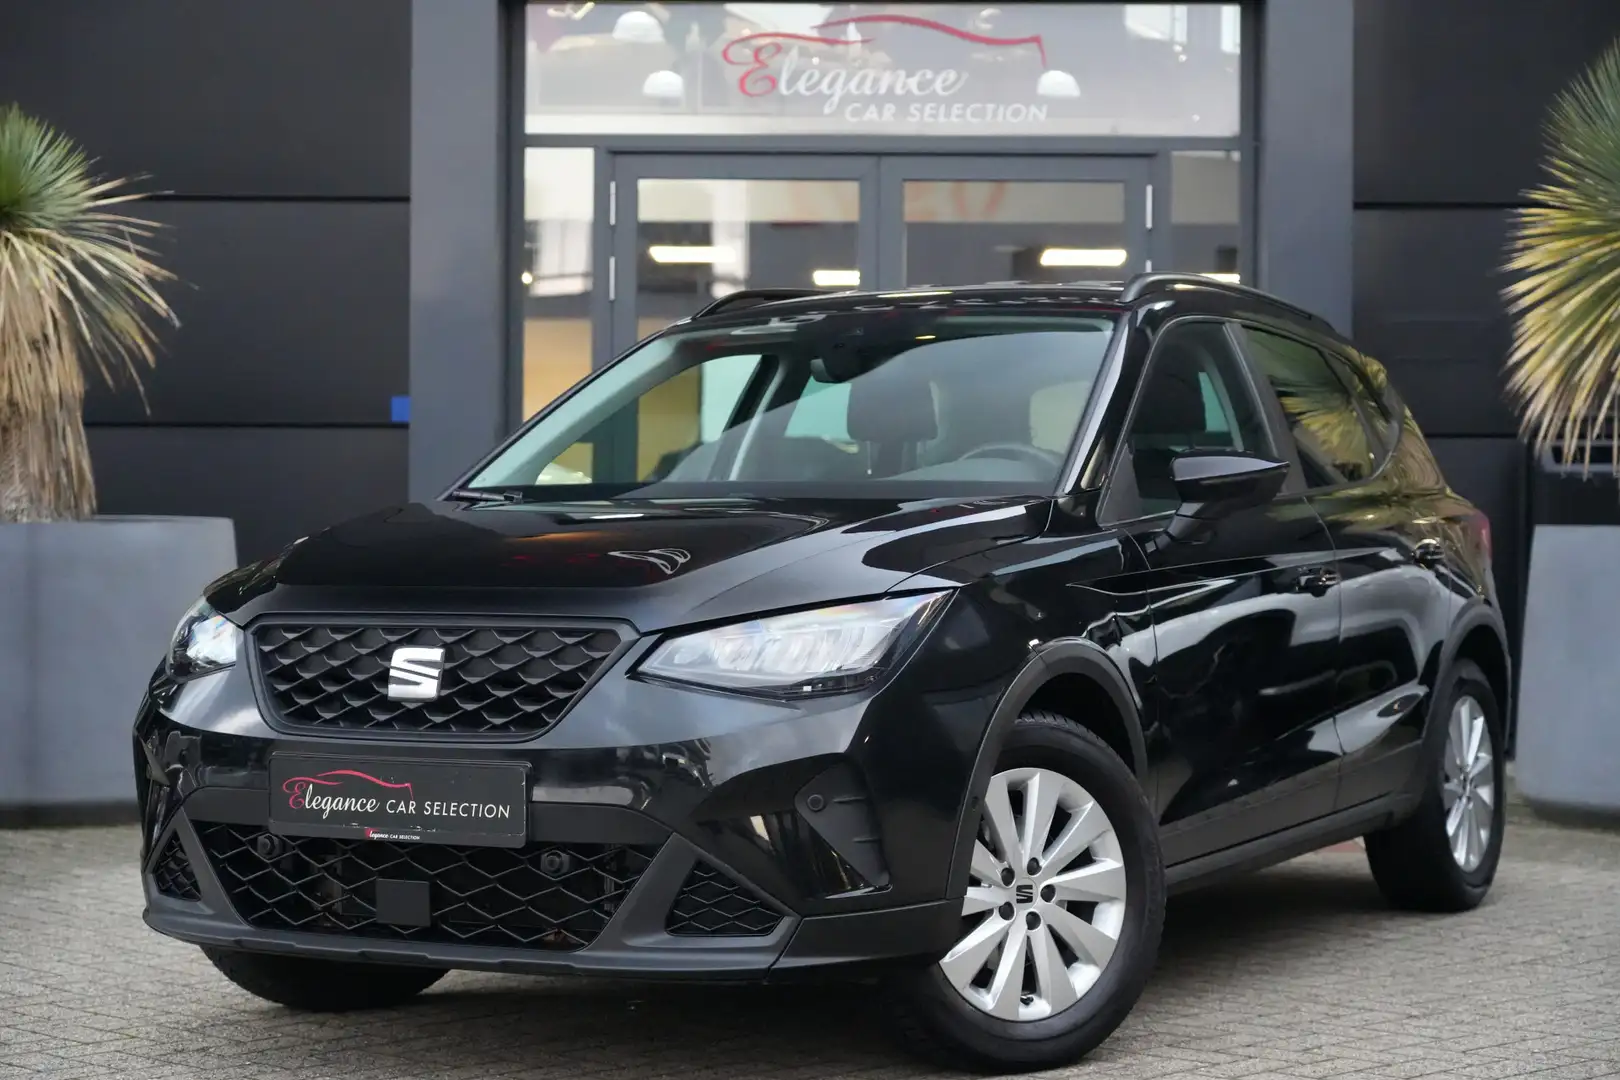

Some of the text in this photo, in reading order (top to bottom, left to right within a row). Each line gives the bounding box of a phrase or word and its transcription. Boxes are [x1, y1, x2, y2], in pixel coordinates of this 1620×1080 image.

[722, 36, 969, 115] Elegance
[844, 102, 1048, 123] CAR SELECTION
[283, 777, 510, 819] Elegance CAR SELECTION
